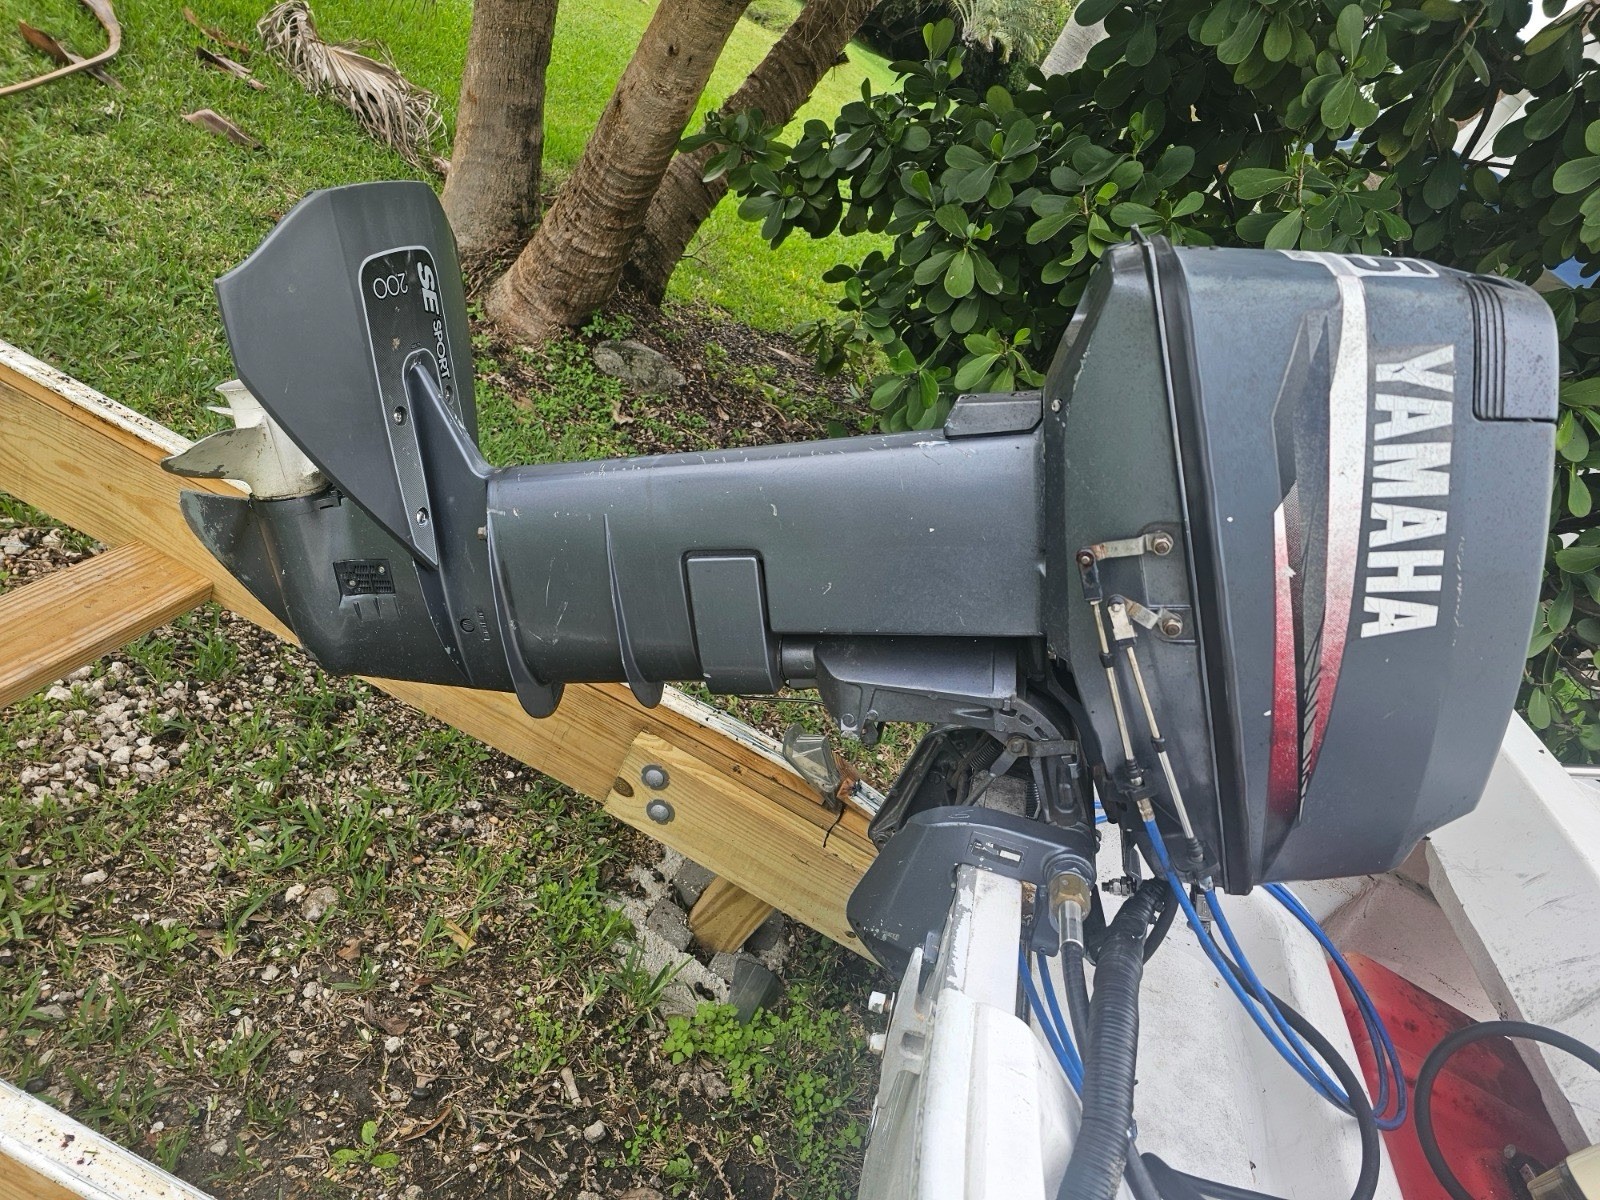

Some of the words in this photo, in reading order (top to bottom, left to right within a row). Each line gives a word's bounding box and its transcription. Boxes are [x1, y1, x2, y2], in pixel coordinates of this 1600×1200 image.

[373, 272, 408, 299] 200
[417, 261, 439, 315] SE
[433, 319, 450, 379] SPORT
[1360, 344, 1454, 638] YAMAHA
